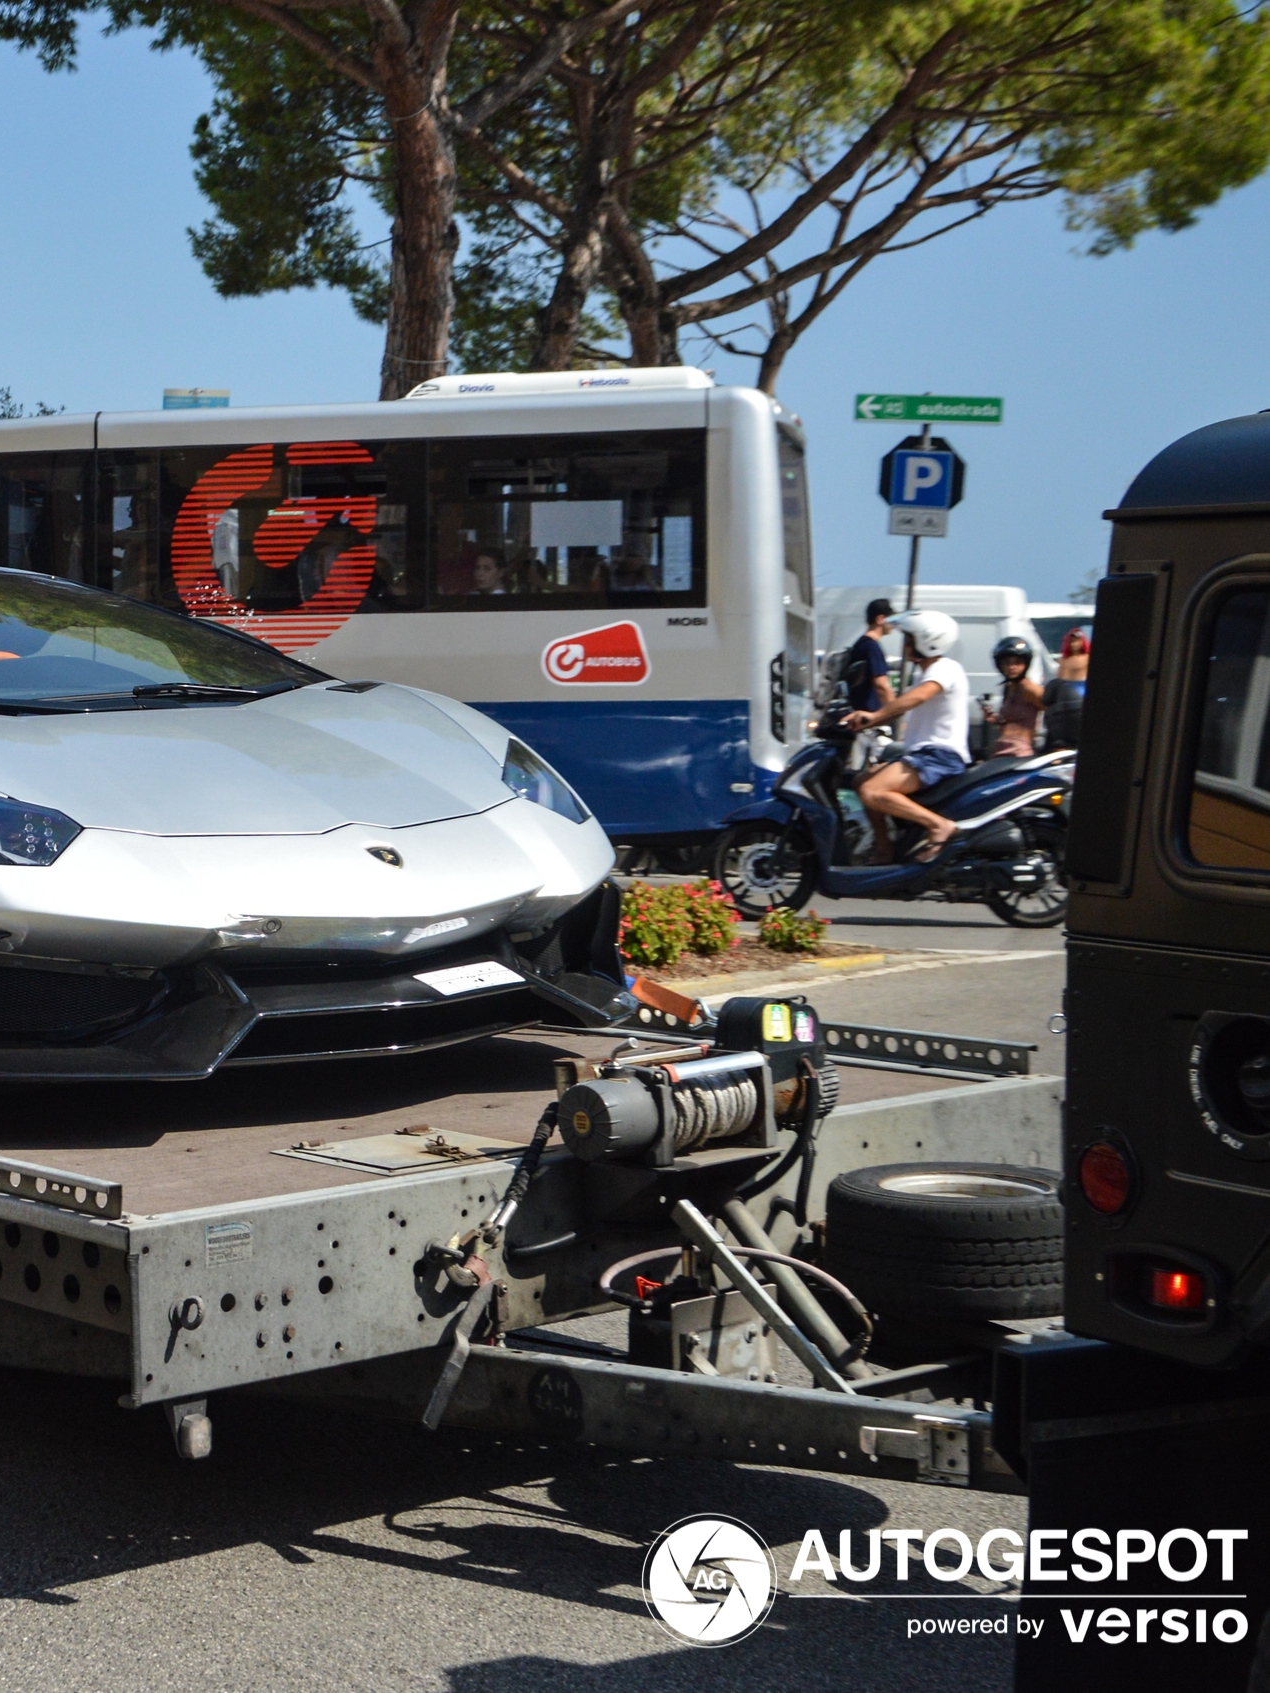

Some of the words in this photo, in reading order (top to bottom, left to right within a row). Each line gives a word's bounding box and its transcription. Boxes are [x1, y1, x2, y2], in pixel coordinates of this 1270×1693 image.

[916, 402, 1000, 417] autostrada
[902, 456, 944, 501] P
[667, 617, 708, 626] MOBI
[584, 656, 642, 667] AUTOBUS
